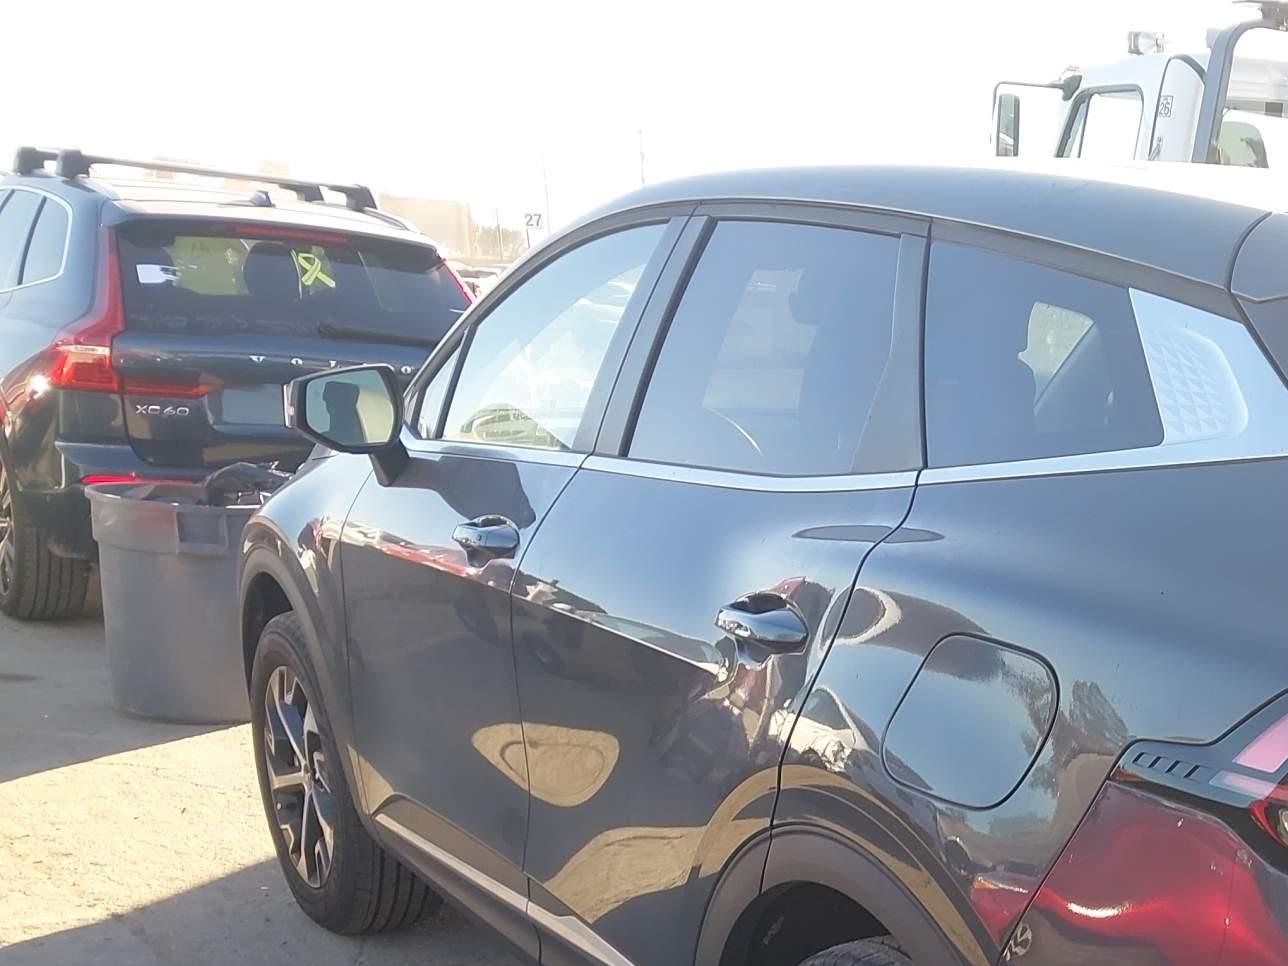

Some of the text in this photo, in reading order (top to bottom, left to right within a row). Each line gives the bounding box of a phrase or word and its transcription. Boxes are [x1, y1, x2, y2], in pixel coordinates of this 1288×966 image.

[1159, 102, 1171, 115] 26
[524, 213, 542, 227] 27
[135, 404, 190, 416] XC60
